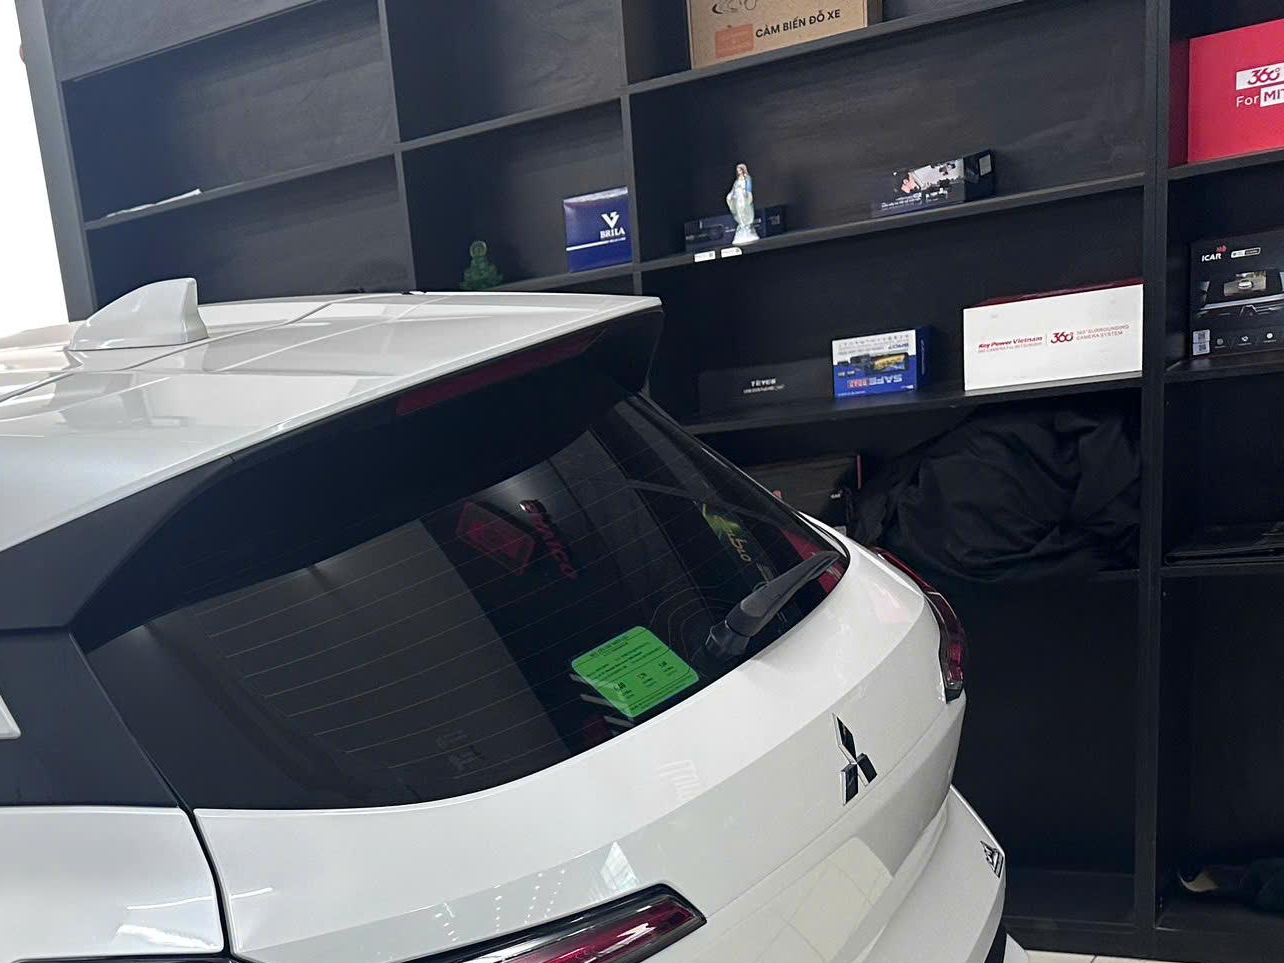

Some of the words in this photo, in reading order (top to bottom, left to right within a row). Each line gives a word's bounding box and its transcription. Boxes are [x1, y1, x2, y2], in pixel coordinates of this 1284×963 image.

[783, 16, 806, 32] BIẾN
[809, 9, 825, 25] ĐỖ
[827, 9, 841, 21] XE
[1236, 96, 1259, 108] For
[600, 228, 625, 239] BRILA
[1201, 253, 1222, 262] ICAR
